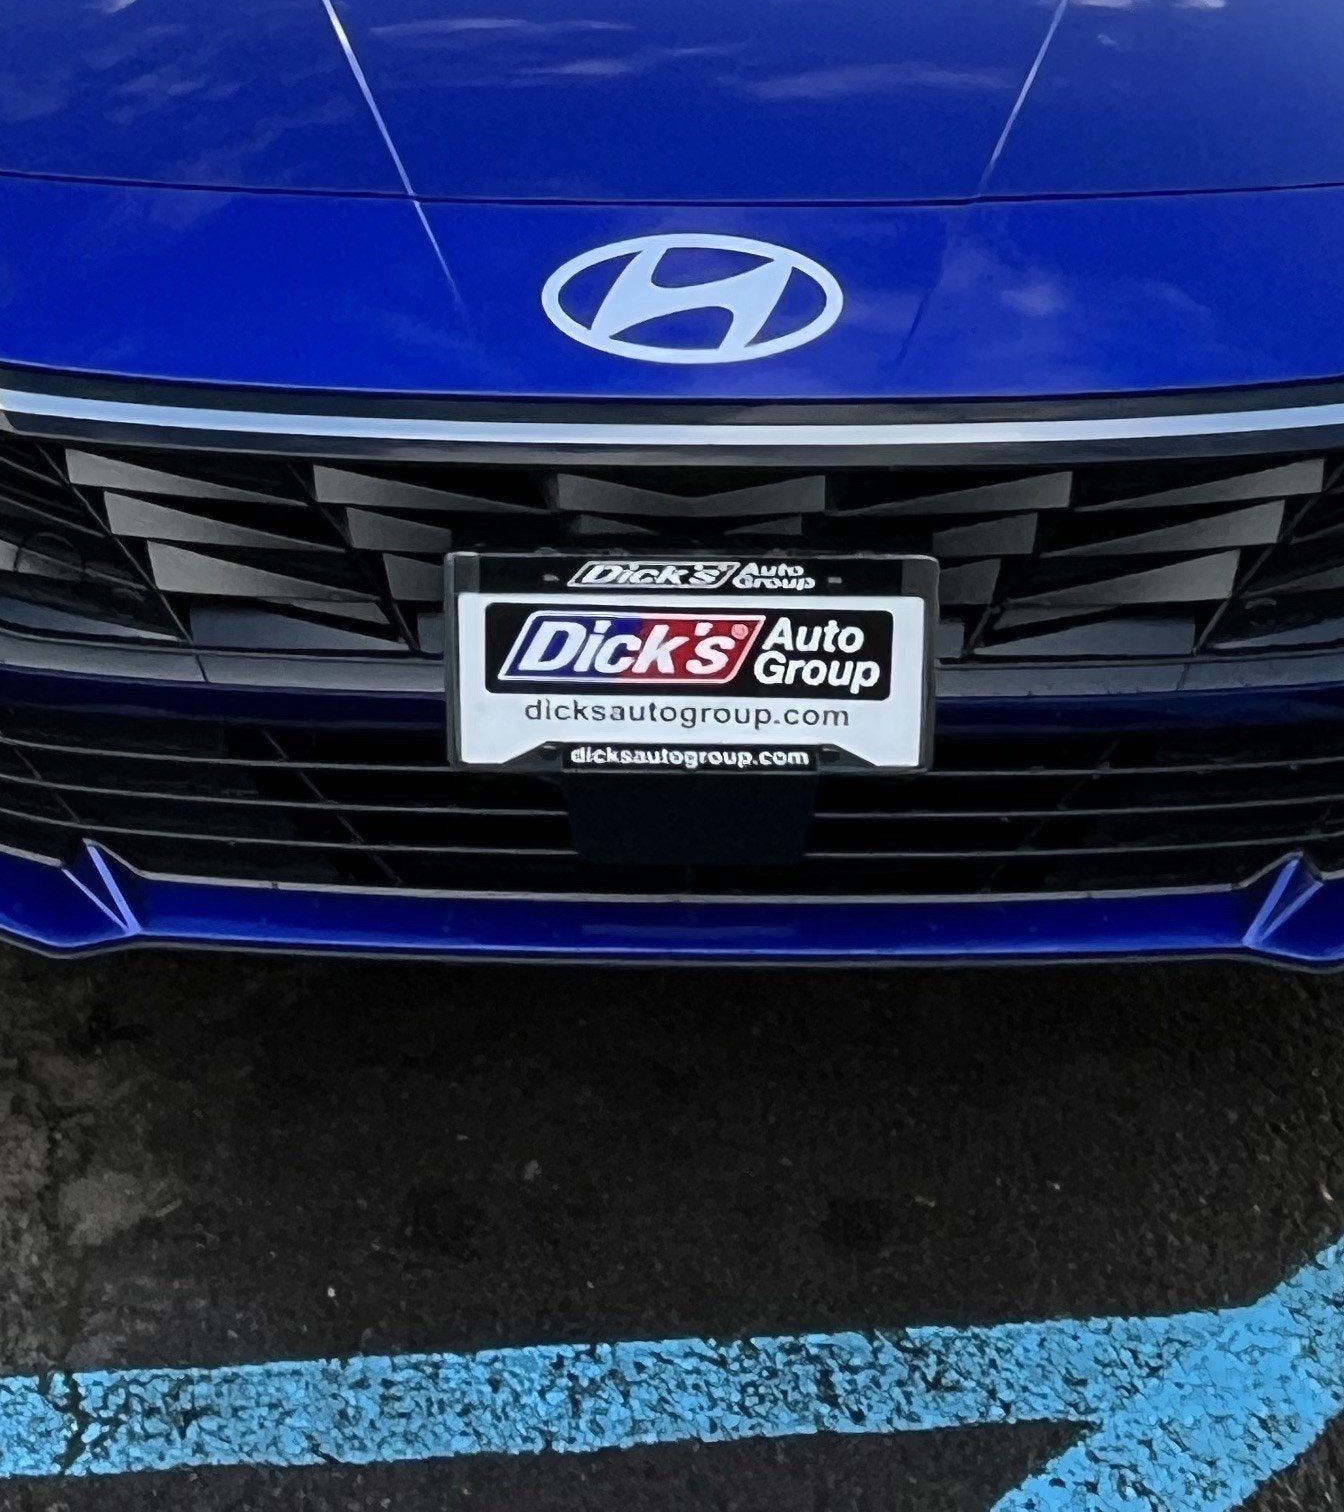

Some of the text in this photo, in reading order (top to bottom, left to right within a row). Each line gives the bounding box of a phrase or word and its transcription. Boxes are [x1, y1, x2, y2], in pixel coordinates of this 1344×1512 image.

[732, 574, 816, 591] Group
[740, 561, 804, 577] Auto
[762, 617, 865, 654] Auto
[753, 652, 881, 694] Group
[524, 698, 850, 729] dicksautogroup.com
[570, 746, 810, 769] dicksautogroup.com
